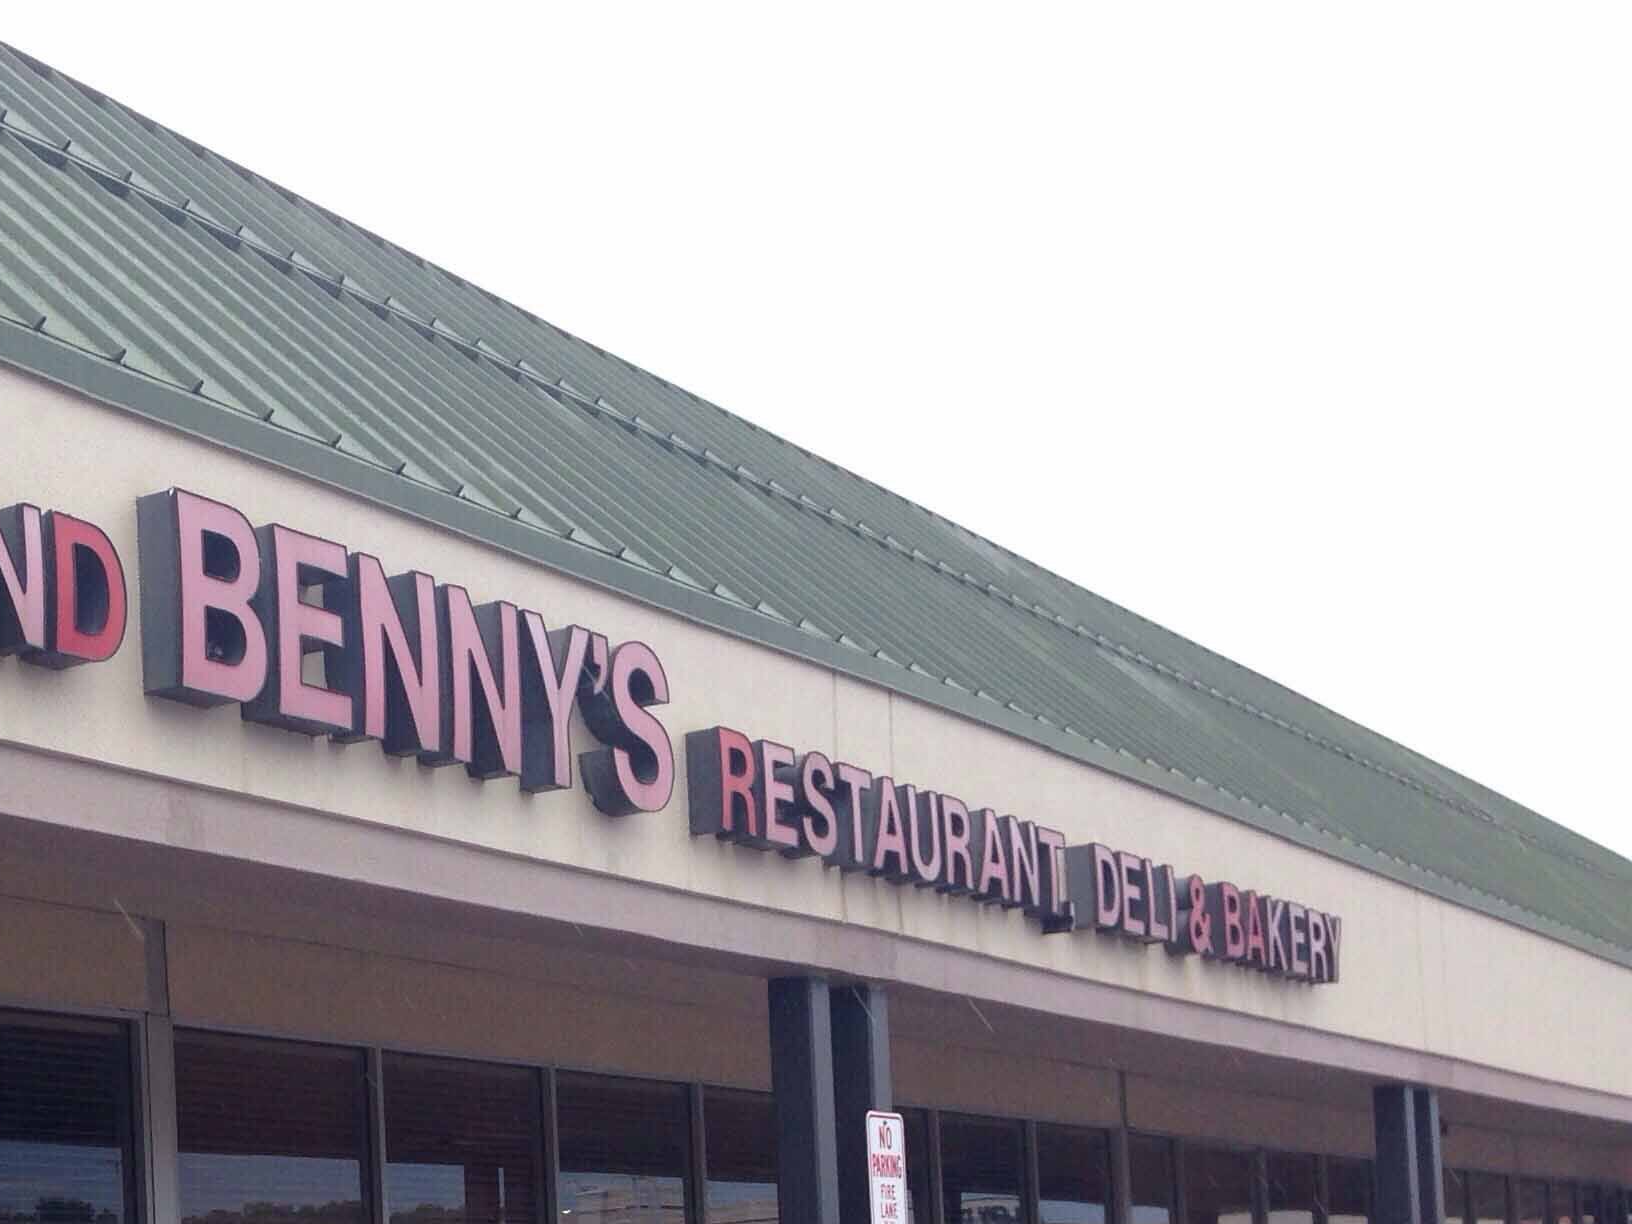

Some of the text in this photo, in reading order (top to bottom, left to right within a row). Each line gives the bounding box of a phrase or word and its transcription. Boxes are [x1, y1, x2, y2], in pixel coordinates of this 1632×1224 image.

[163, 486, 675, 815] BENNY'S
[1086, 842, 1177, 944] DELI
[1185, 873, 1214, 954] &
[1218, 881, 1342, 984] BAKERY
[878, 1126, 893, 1150] NO
[872, 1153, 903, 1179] PARKING
[880, 1184, 896, 1201] FIRE
[880, 1202, 898, 1219] LANE
